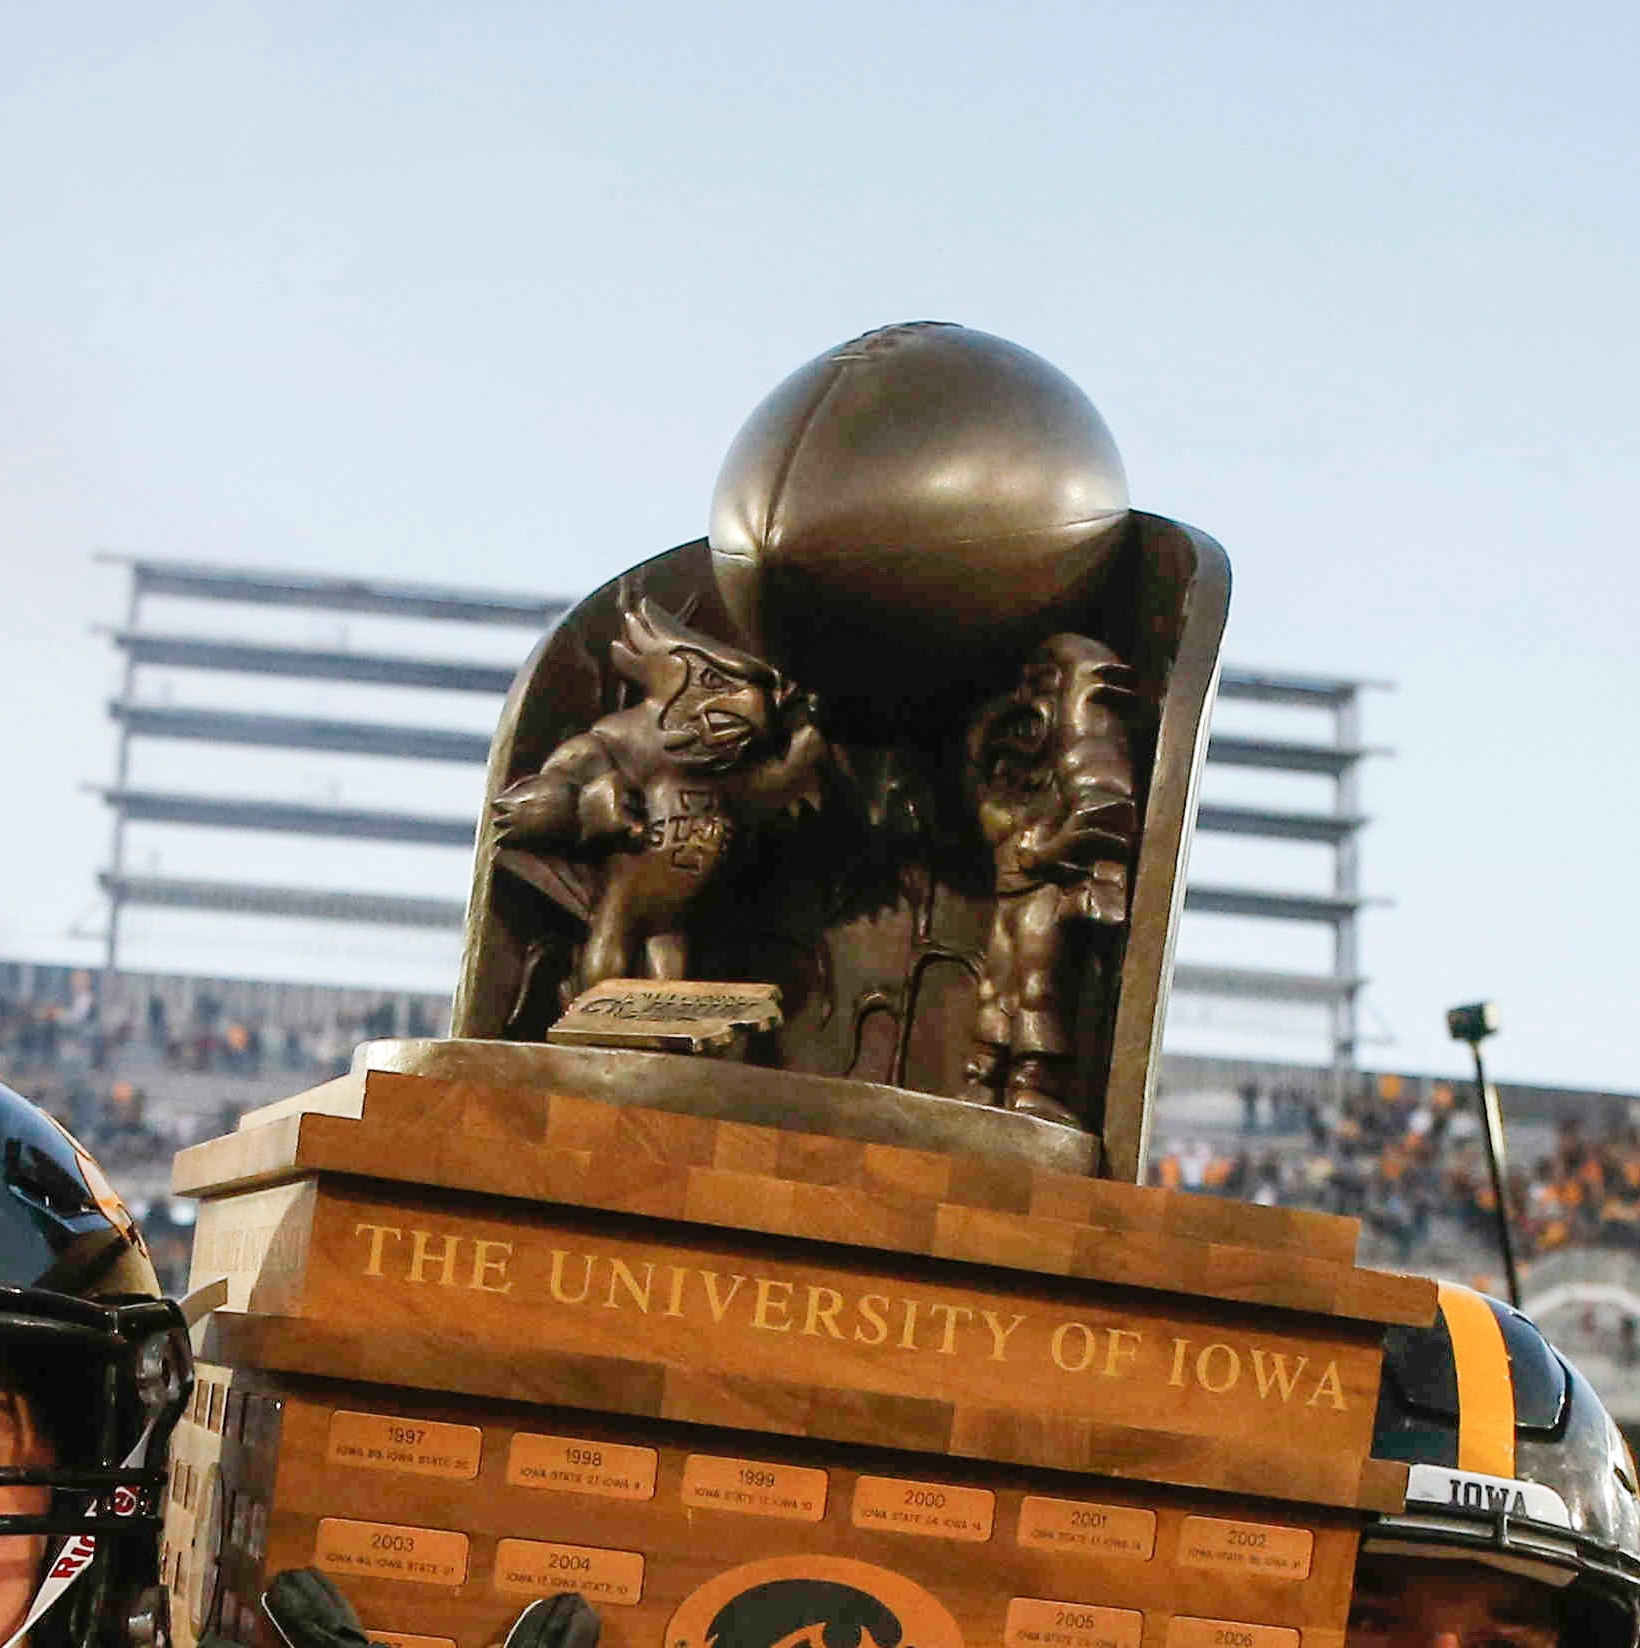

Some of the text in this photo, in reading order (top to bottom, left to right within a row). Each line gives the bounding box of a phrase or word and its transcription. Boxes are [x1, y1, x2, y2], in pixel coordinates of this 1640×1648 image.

[354, 1223, 513, 1294] THE
[549, 1248, 1026, 1361] UNIVERSITY
[1051, 1322, 1144, 1377] OF
[1167, 1337, 1348, 1412] IOWA
[387, 1426, 426, 1445] 1997
[565, 1447, 603, 1467] 1998
[737, 1467, 775, 1488] 1999
[903, 1488, 946, 1509] 2000
[1449, 1479, 1529, 1519] IOWA
[1070, 1509, 1109, 1530] 2001
[371, 1532, 415, 1553] 2003
[548, 1552, 591, 1571] 2004
[1054, 1611, 1096, 1630] 2005
[1214, 1629, 1254, 1648] 2006
